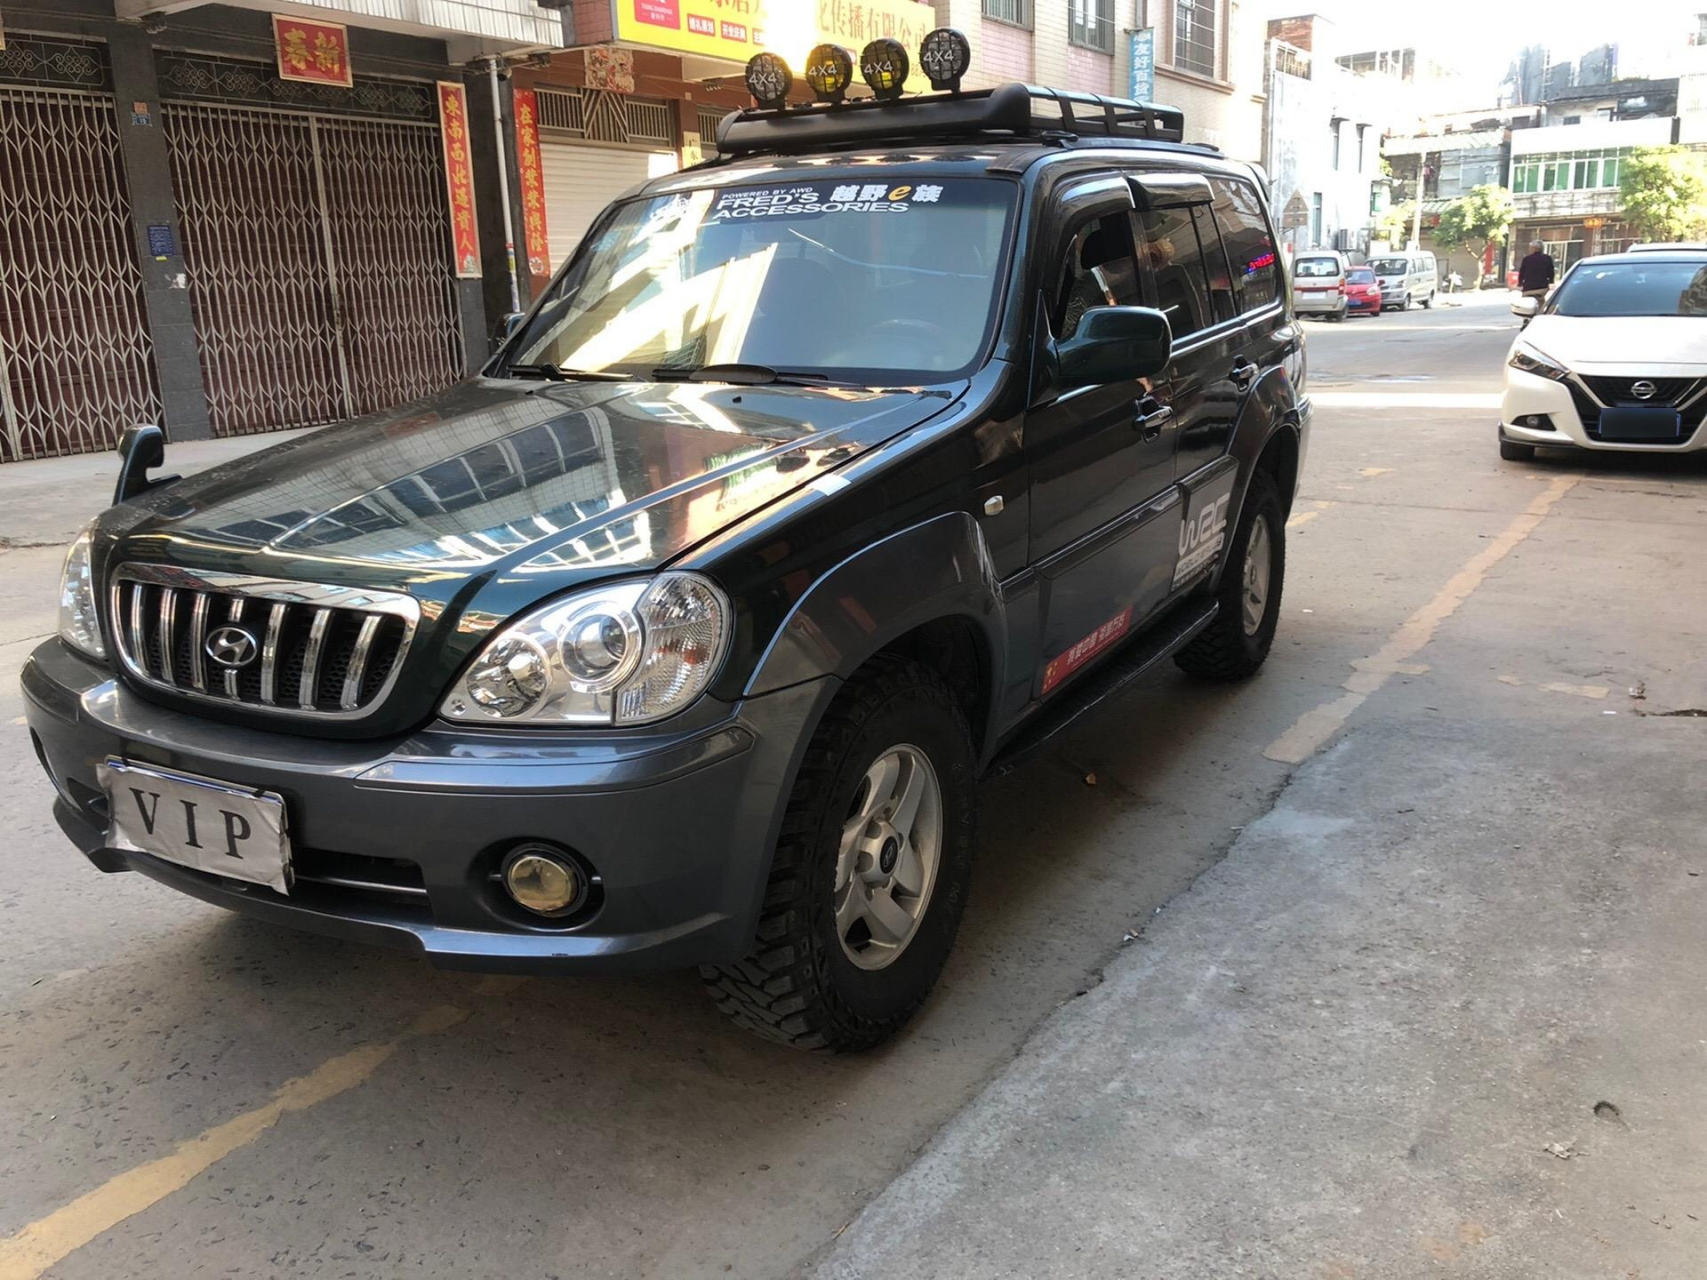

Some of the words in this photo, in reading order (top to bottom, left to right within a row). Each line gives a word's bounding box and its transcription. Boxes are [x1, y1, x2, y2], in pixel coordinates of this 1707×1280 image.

[923, 50, 955, 63] 4X4
[808, 64, 837, 77] 4X4
[864, 61, 893, 75] 4X4
[749, 73, 777, 85] 4X4
[716, 192, 820, 210] FRED'S
[722, 190, 768, 200] POWERED
[712, 202, 909, 219] ACCESSORIES
[129, 787, 251, 859] VIP
